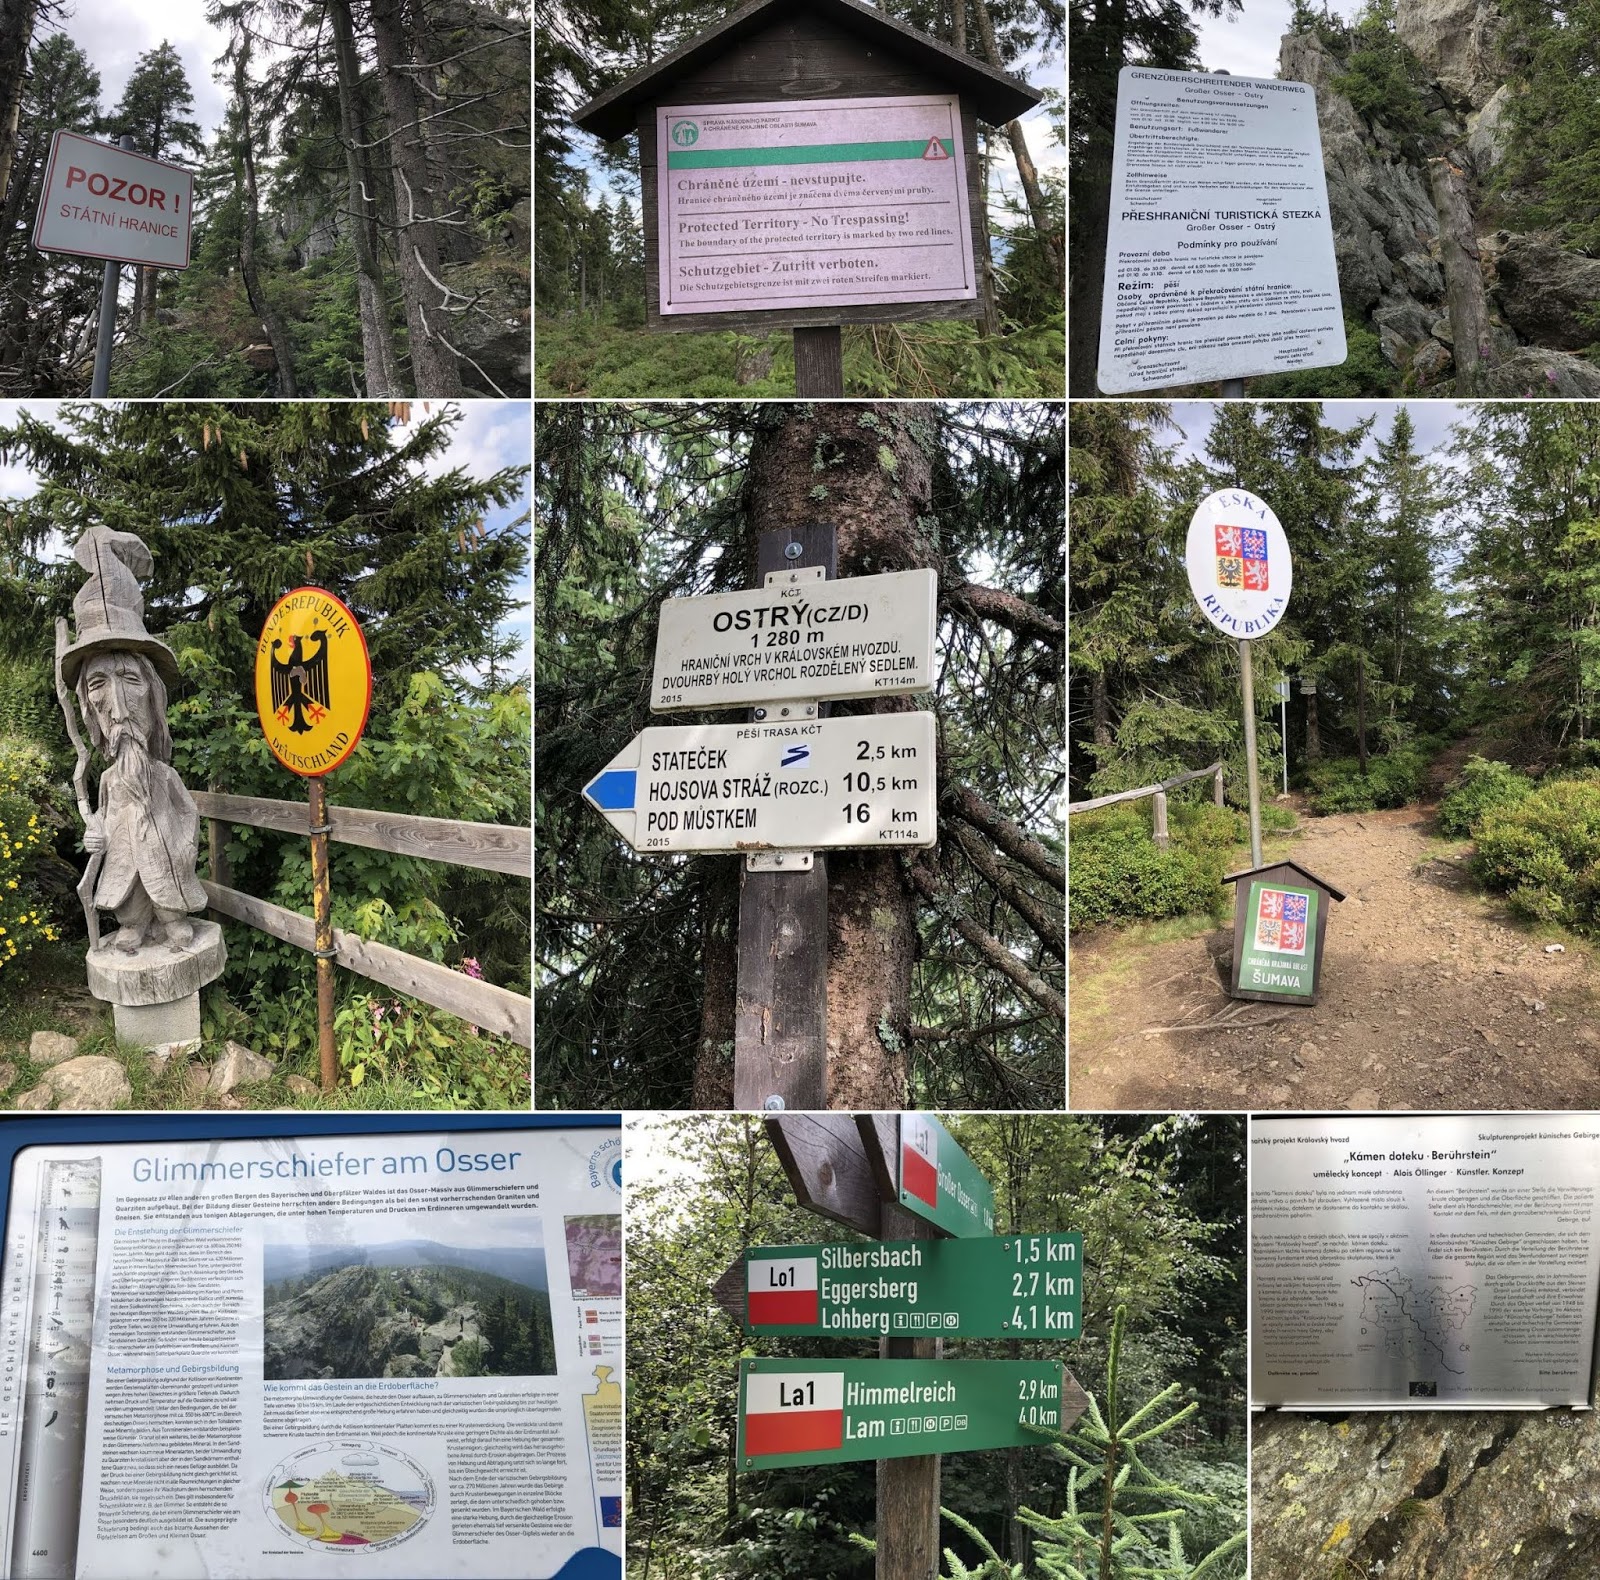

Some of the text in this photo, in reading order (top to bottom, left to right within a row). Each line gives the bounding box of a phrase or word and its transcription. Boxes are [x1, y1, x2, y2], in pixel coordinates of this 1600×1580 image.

[1131, 72, 1306, 93] GRENZÜBERSCHREITENDER WANDERWEG
[1176, 97, 1268, 110] Benutzungsvoraussetzungen
[66, 166, 180, 213] POZOR !
[678, 173, 866, 190] Chráněné území nevstupujte.
[60, 204, 178, 238] STÁTNÍ HRANICE
[679, 212, 909, 233] Protected Territory No Trespassing!
[1122, 207, 1321, 220] PŘESHRANIČNÍ TURISTICKÁ STEZKA
[1254, 222, 1276, 231] Ostrý
[697, 238, 737, 246] boundary
[764, 234, 803, 245] protected
[806, 233, 841, 243] territory
[852, 230, 884, 239] marked
[886, 230, 896, 239] by
[1178, 240, 1221, 249] Podmínky
[1241, 238, 1278, 247] používání
[679, 258, 878, 277] Schutzgebiet Zutritt verboten.
[1118, 280, 1180, 290] Režim: pěší
[1149, 289, 1188, 300] oprávněné
[1198, 286, 1242, 296] překračování
[1245, 284, 1264, 293] státní
[1267, 283, 1293, 292] hranice:
[1115, 334, 1169, 346] Celní pokyny:
[1203, 594, 1283, 633] REPUBLIKA
[260, 595, 350, 654] BUNDESREPUBLIK
[751, 630, 824, 648] 1 280 m
[681, 641, 900, 671] HRANIČNÍ VRCH V KRÁLOVSKÉM HVOZDU.
[662, 656, 918, 689] DVOUHRBÝ HOLÝ VRCHOL ROZDĚLENÝ SEDLEM.
[875, 677, 915, 686] KT114m
[660, 694, 682, 703] 2015
[737, 724, 822, 739] PĚŠÍ TRASA KČT
[272, 732, 349, 769] DEUTSCHLAND
[652, 741, 916, 771] STATEČEK 2,5 km
[649, 772, 917, 801] HOJSOVA STRÁŽ (ROZC.) 10,5 km
[648, 803, 917, 831] POD MŮSTKEM 16 km
[647, 838, 670, 846] 2015
[879, 830, 918, 839] KT114a
[1252, 968, 1300, 988] ŠUMAVA
[1478, 1133, 1537, 1141] Skulpturenprojekt
[134, 1148, 522, 1182] Glimmerschiefer am Osser
[1344, 1150, 1496, 1163] „Kámen doteku Berührstein“
[588, 1150, 601, 1188] Bayerns
[1313, 1170, 1349, 1179] umělecký
[1352, 1170, 1382, 1179] koncept
[1415, 1168, 1446, 1178] Öllinger
[1492, 1168, 1524, 1176] Konzept
[937, 1162, 957, 1199] Großer
[822, 1238, 1075, 1269] Silbersbach 1,5 km
[770, 1267, 794, 1287] Lo1
[822, 1272, 1074, 1305] Eggersberg 2,7 km
[822, 1305, 1073, 1334] Lohberg 4,1 km
[0, 1234, 26, 1436] DIE GESCHICHTE DER ERDE
[107, 1366, 164, 1375] Metamorphose
[182, 1364, 239, 1374] Gebirgsbildung
[324, 1383, 352, 1391] Gestein
[378, 1381, 439, 1390] Erdoberfläche?
[780, 1381, 814, 1407] La1
[847, 1380, 1057, 1406] Himmelreich 2,9 km
[846, 1416, 885, 1439] Lam
[1039, 1406, 1057, 1425] km
